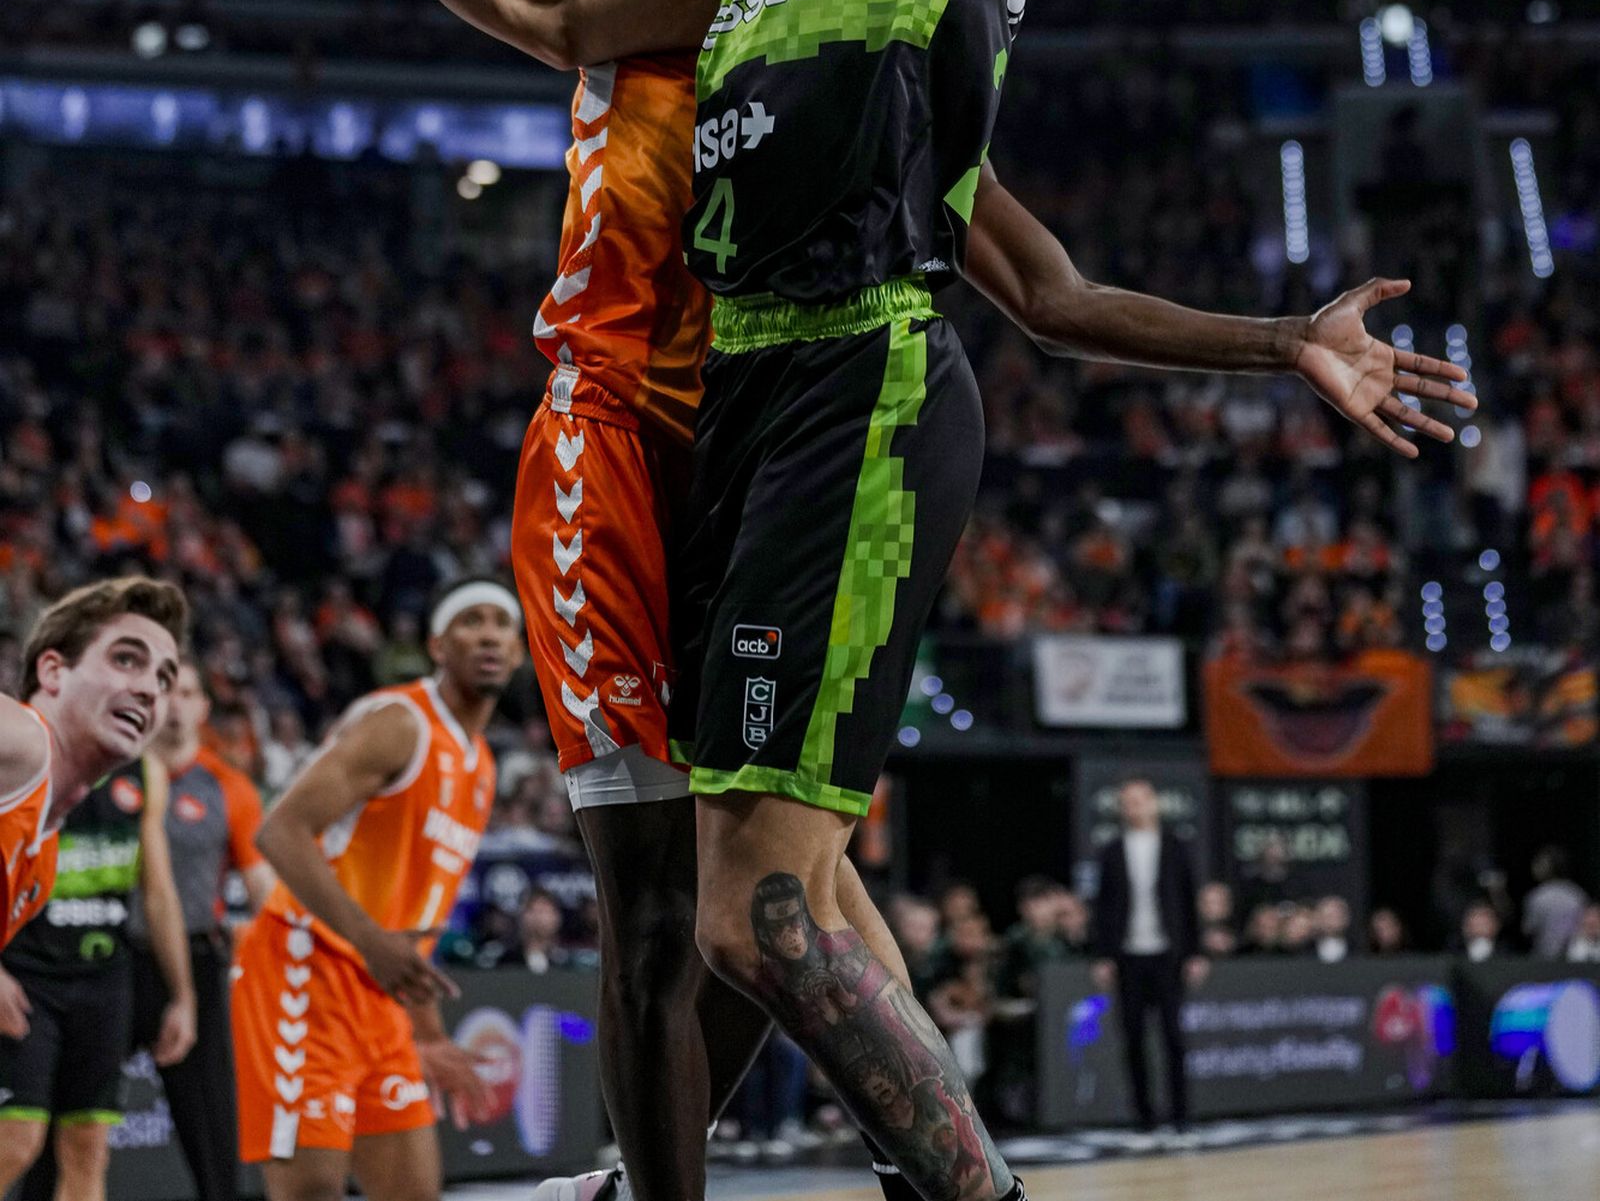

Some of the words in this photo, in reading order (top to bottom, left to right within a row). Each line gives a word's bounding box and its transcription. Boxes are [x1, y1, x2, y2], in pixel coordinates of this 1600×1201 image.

[683, 177, 738, 274] 4
[737, 638, 769, 654] acb
[608, 693, 642, 705] hummel
